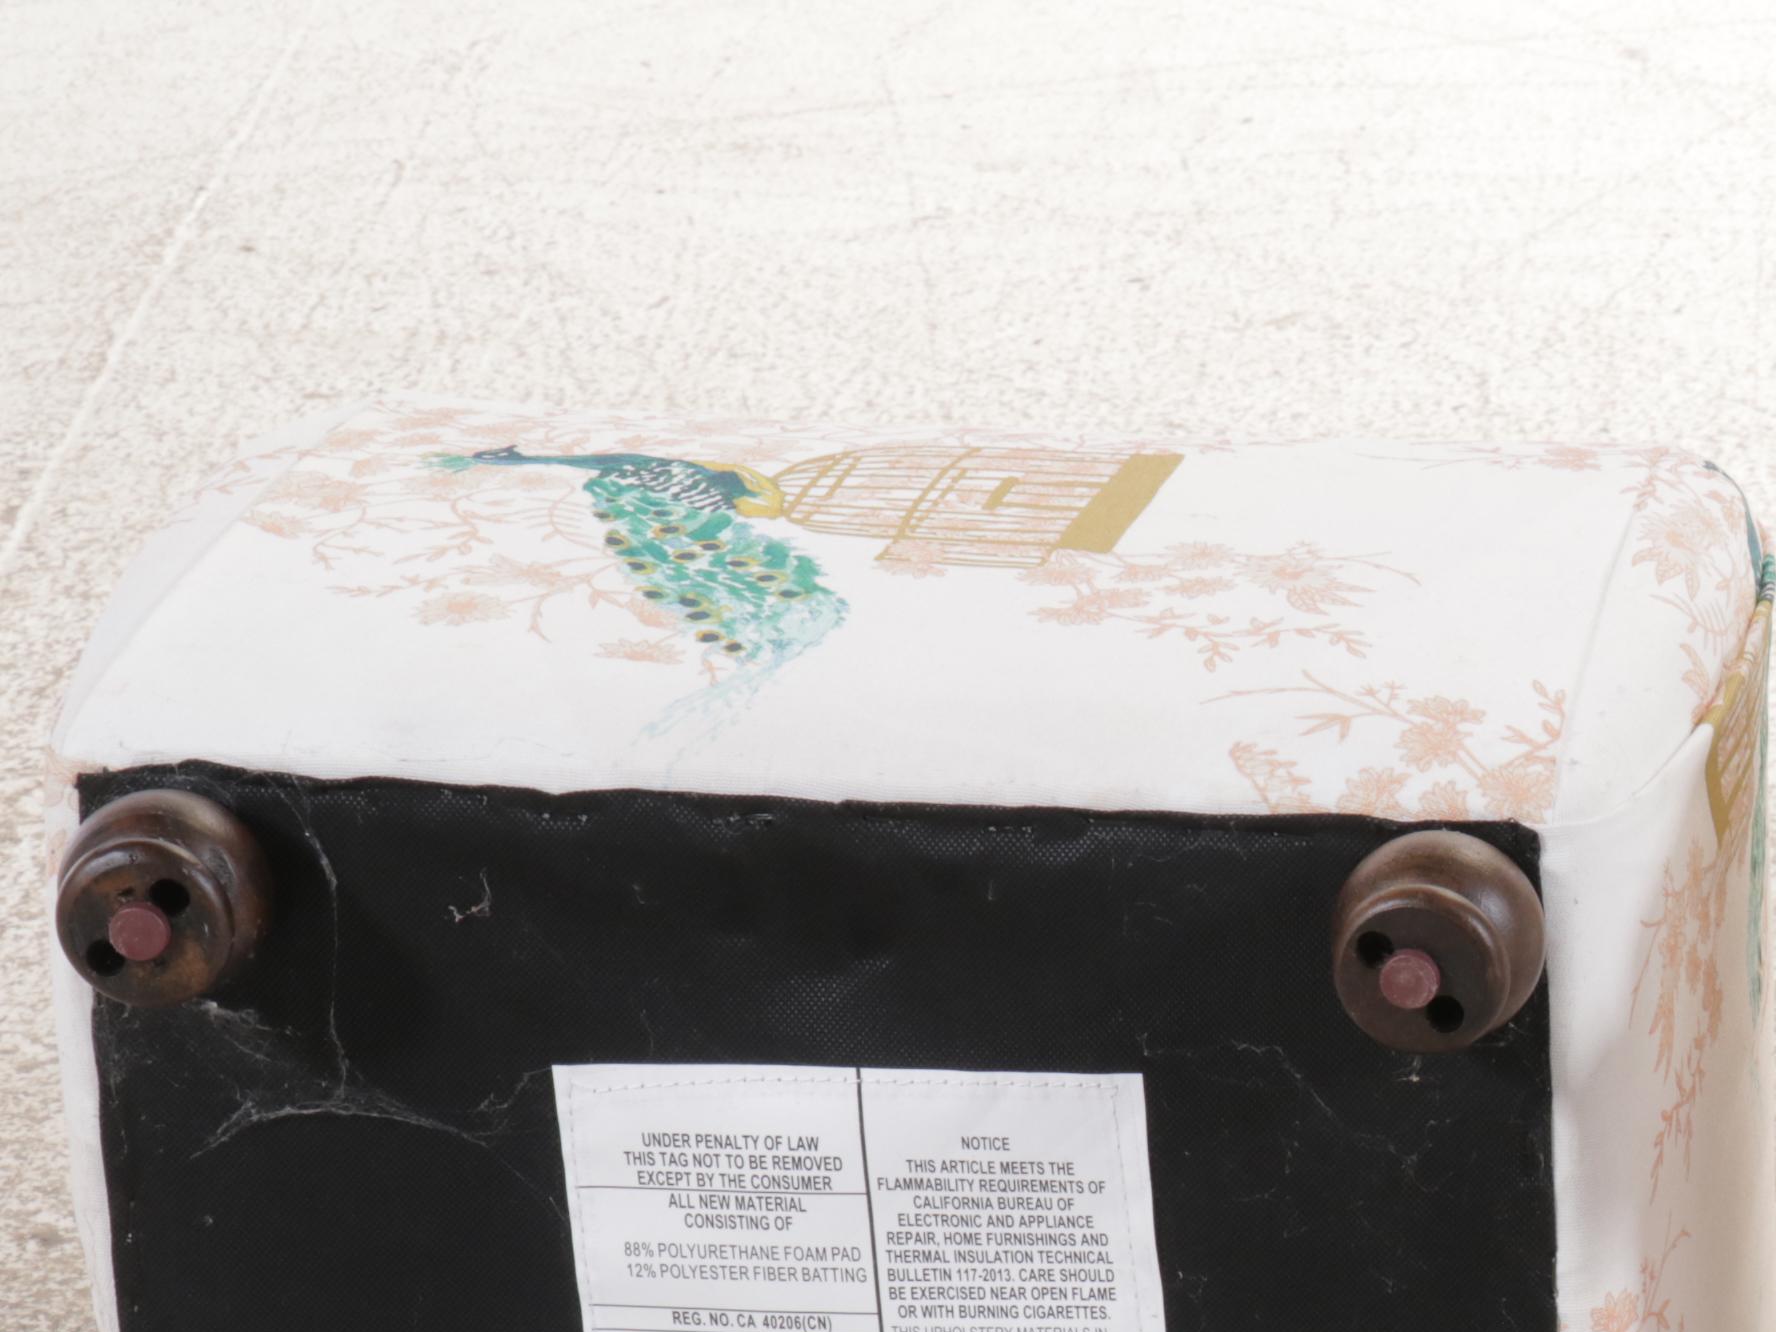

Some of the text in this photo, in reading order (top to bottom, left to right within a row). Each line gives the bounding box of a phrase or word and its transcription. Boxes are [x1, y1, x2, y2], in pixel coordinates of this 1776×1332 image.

[642, 1133, 819, 1151] UNDER PENALTY OF LAW
[961, 1136, 1010, 1151] NOTICE
[623, 1151, 843, 1171] THIS TAG NOT TO BE REMOVED
[906, 1159, 1075, 1176] THIS ARTICLE MEETS THE
[637, 1170, 832, 1191] EXCEPT BY THE CONSUMER
[877, 1177, 1105, 1194] FLAMMABILITY REQUIREMENTS OF
[669, 1193, 807, 1212] ALL NEW MATERIAL
[913, 1195, 1074, 1211] CALIFORNIA BUREAU OF
[684, 1213, 792, 1231] CONSISTING OF
[624, 1242, 861, 1262] 88% POLYURETHANE FOAM PAD
[627, 1263, 867, 1283] 12% POLYESTER FIBER BATTING
[672, 1311, 832, 1332] REG. NO. CA 40206(CN)
